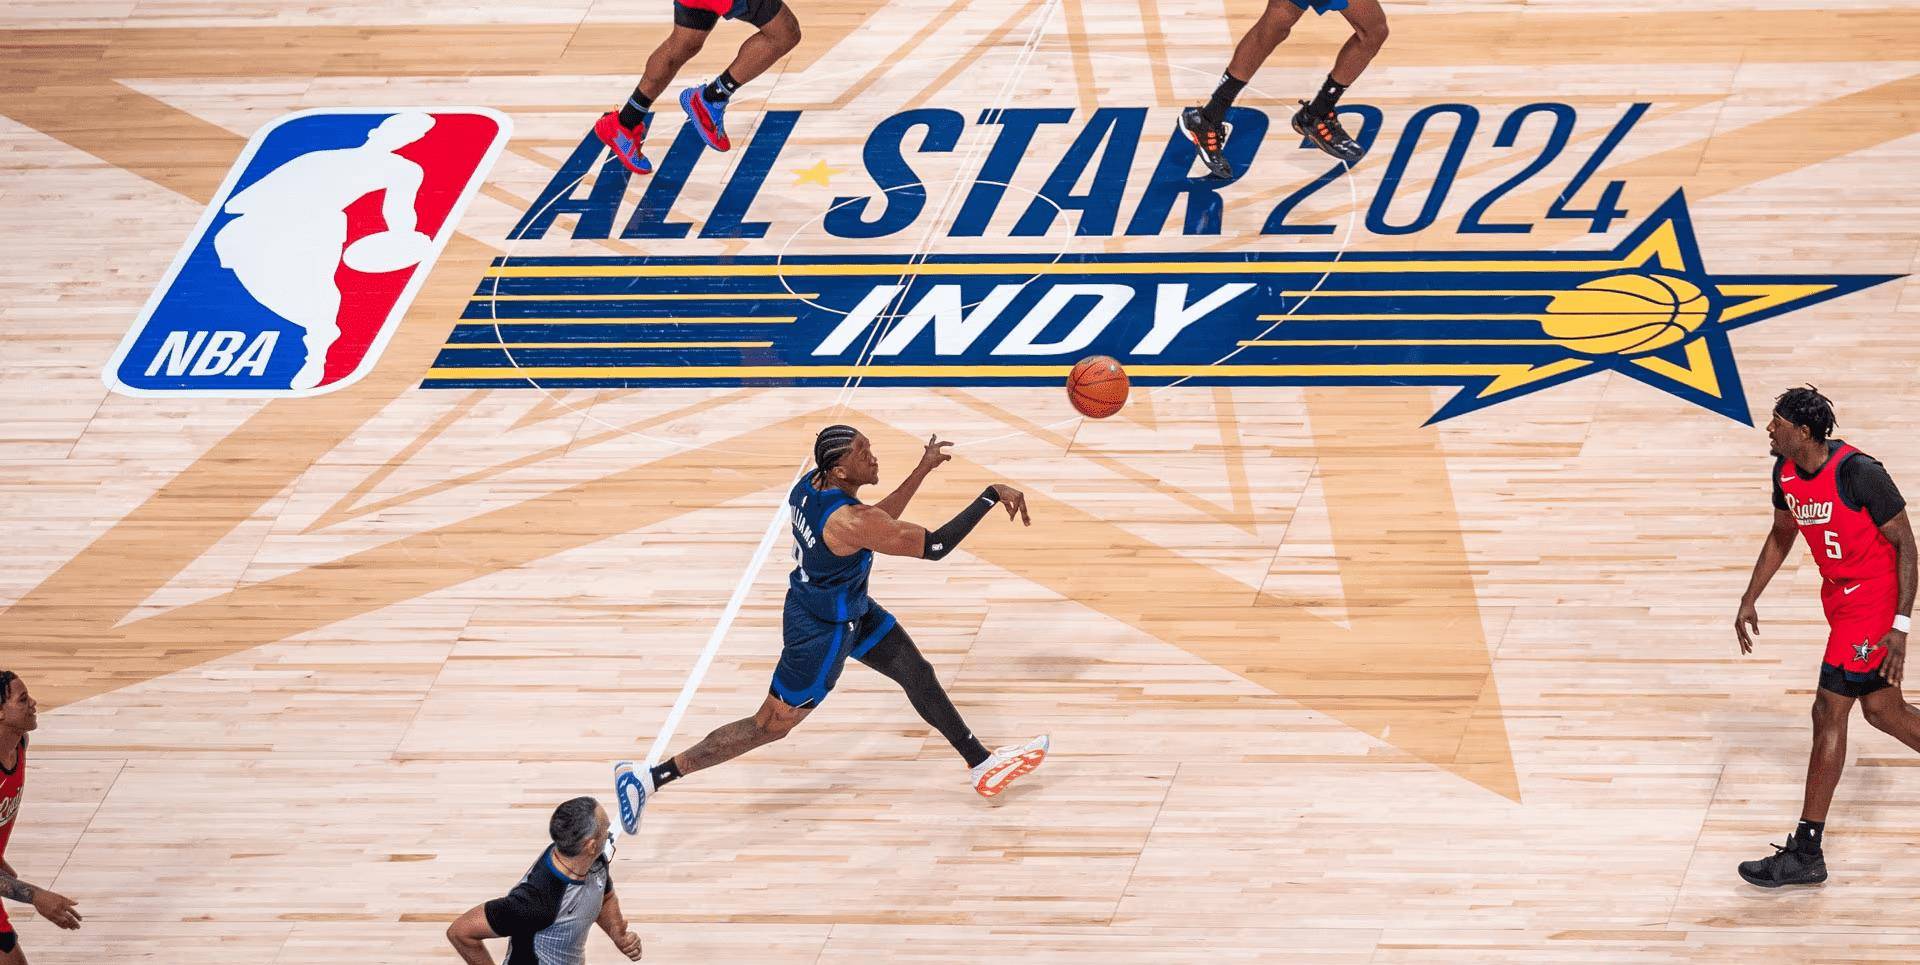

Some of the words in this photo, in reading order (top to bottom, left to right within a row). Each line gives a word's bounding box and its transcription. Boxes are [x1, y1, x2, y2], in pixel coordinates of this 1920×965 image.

[505, 110, 803, 240] ALL
[823, 106, 1269, 238] STAR
[1260, 102, 1652, 235] 2024
[811, 283, 1258, 356] INDY
[144, 330, 281, 376] NBA
[1824, 530, 1842, 559] 5
